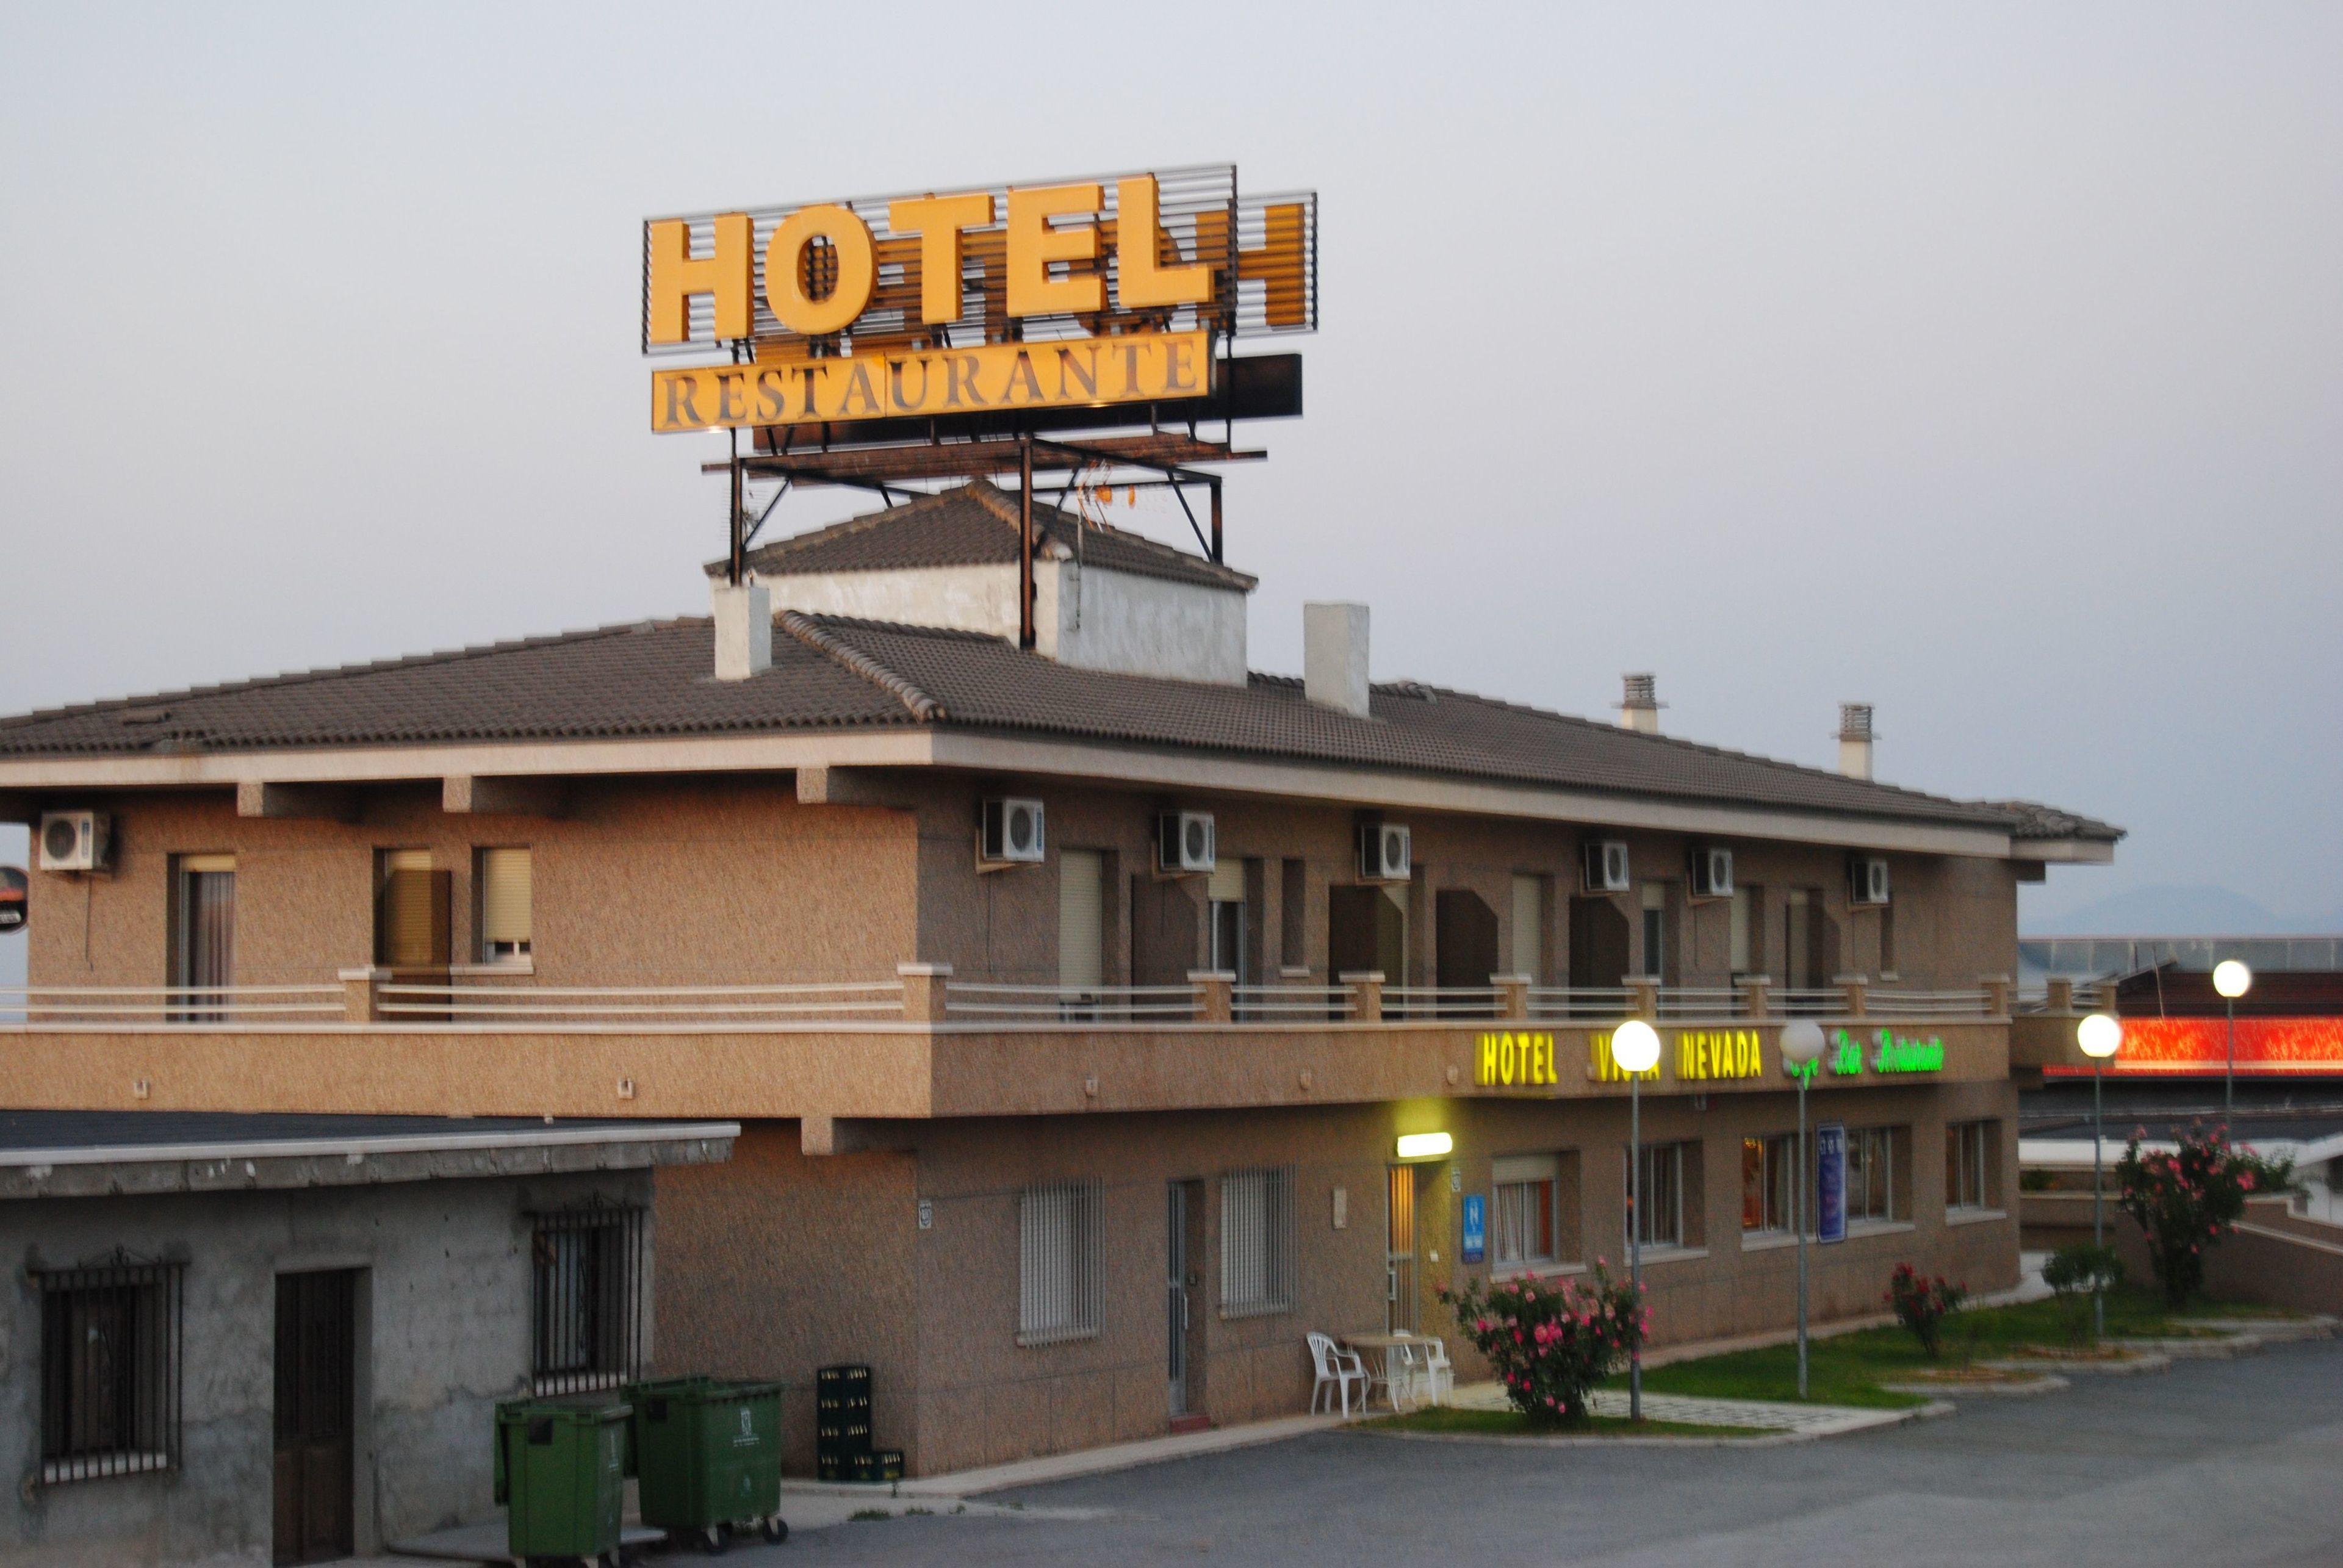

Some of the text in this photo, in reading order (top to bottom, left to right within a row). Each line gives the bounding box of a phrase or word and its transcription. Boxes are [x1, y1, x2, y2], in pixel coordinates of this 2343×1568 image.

[649, 172, 1214, 343] HOTEL
[661, 339, 1198, 428] RESTAURANTE
[1483, 1030, 1558, 1085] HOTEL
[1682, 1029, 1762, 1079] NEVADA
